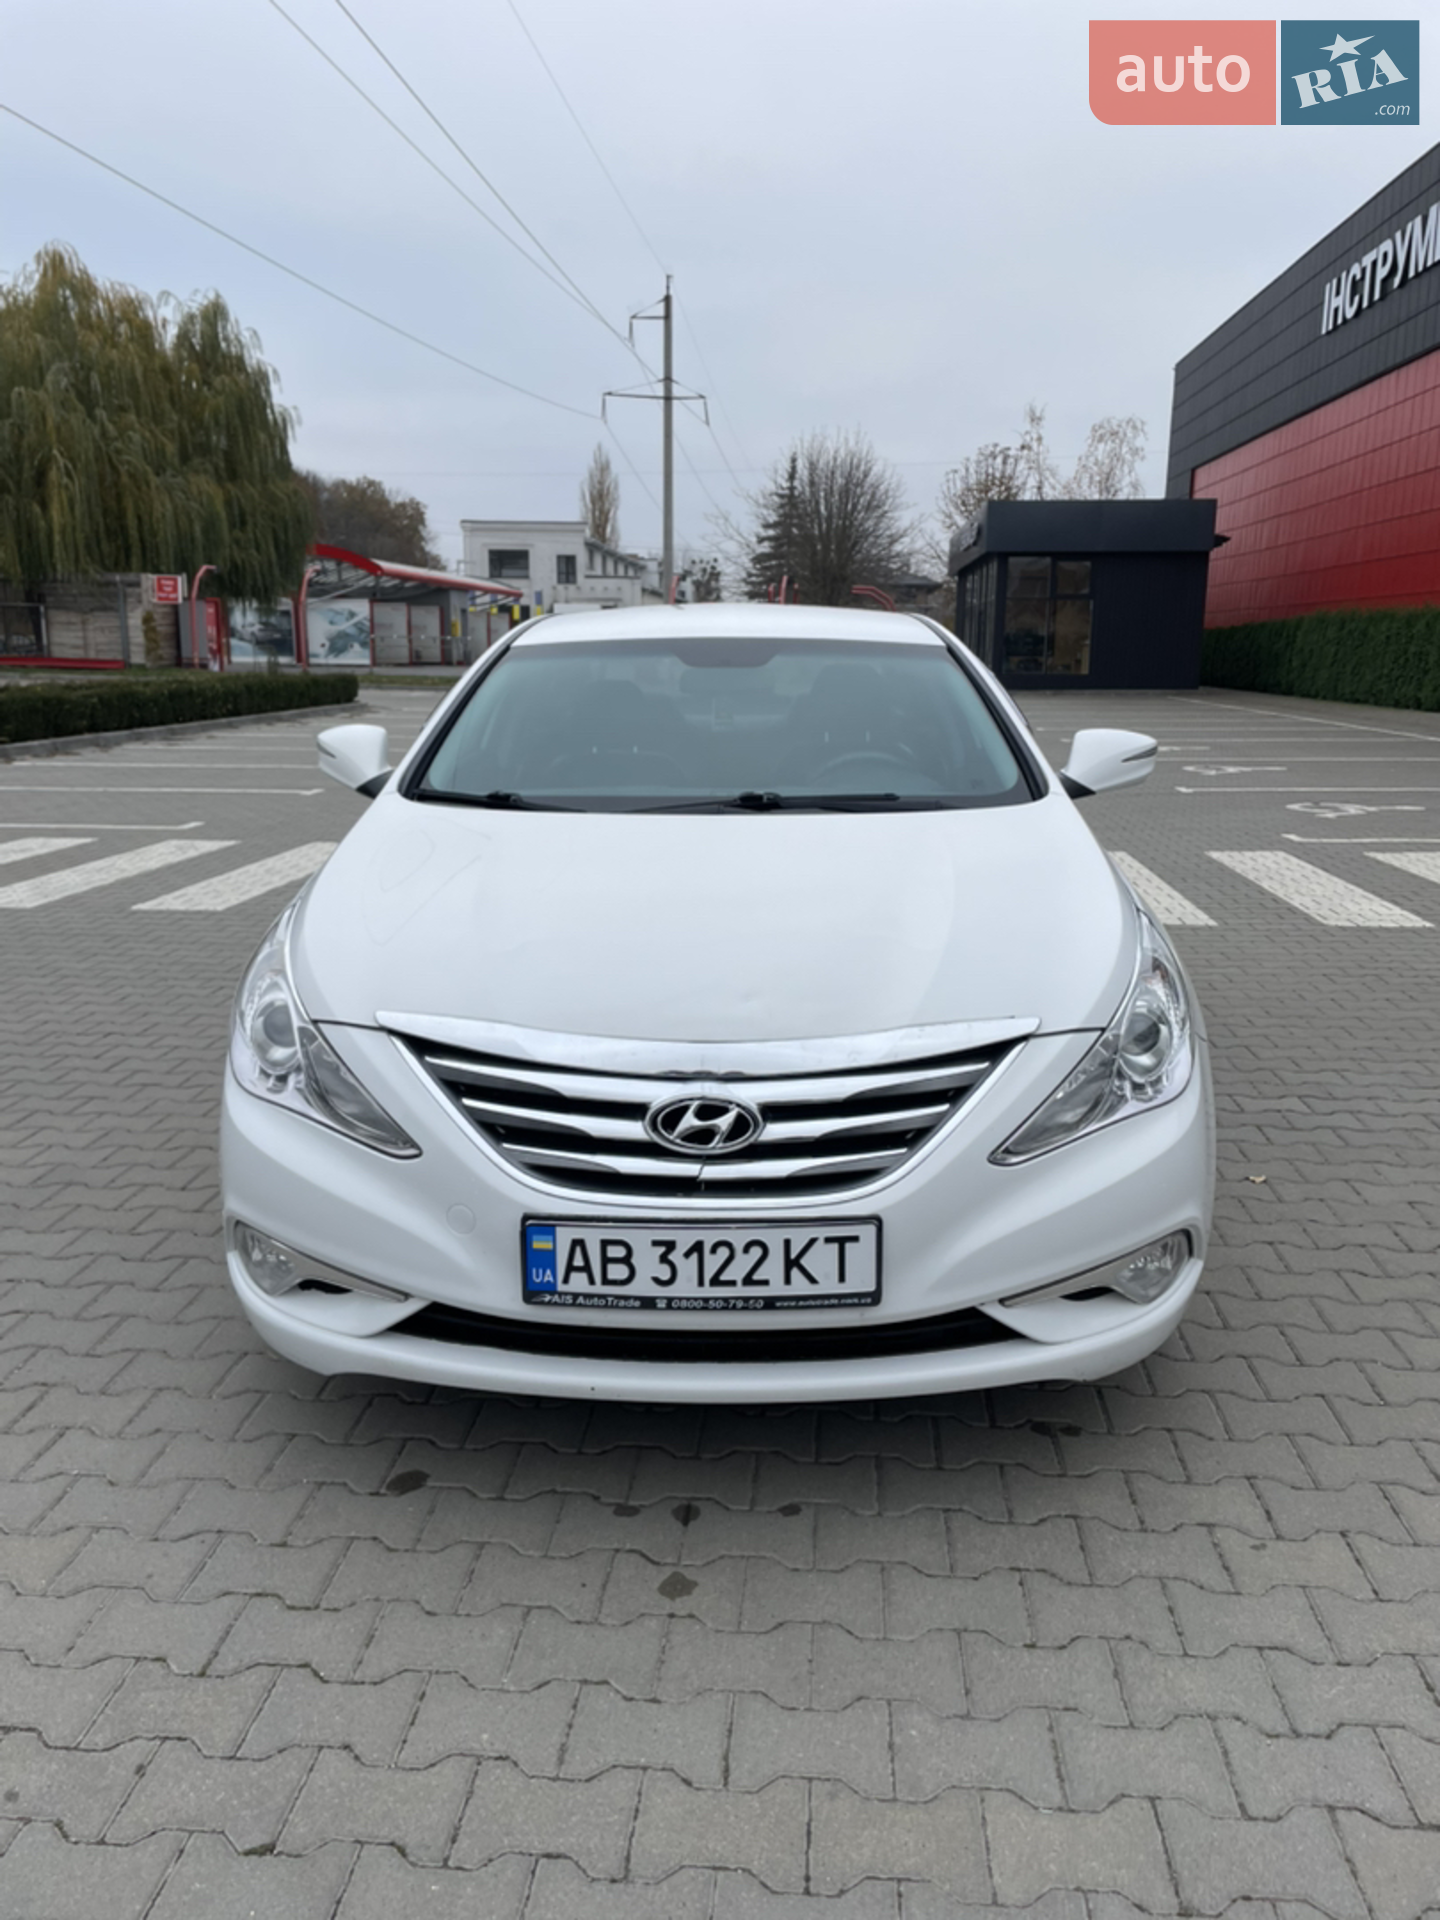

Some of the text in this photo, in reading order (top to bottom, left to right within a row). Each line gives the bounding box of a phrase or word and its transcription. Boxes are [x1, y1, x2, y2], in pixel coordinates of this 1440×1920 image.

[562, 1235, 860, 1288] AB 3122 KT
[532, 1267, 555, 1284] UA
[575, 1296, 641, 1308] AutoTrade
